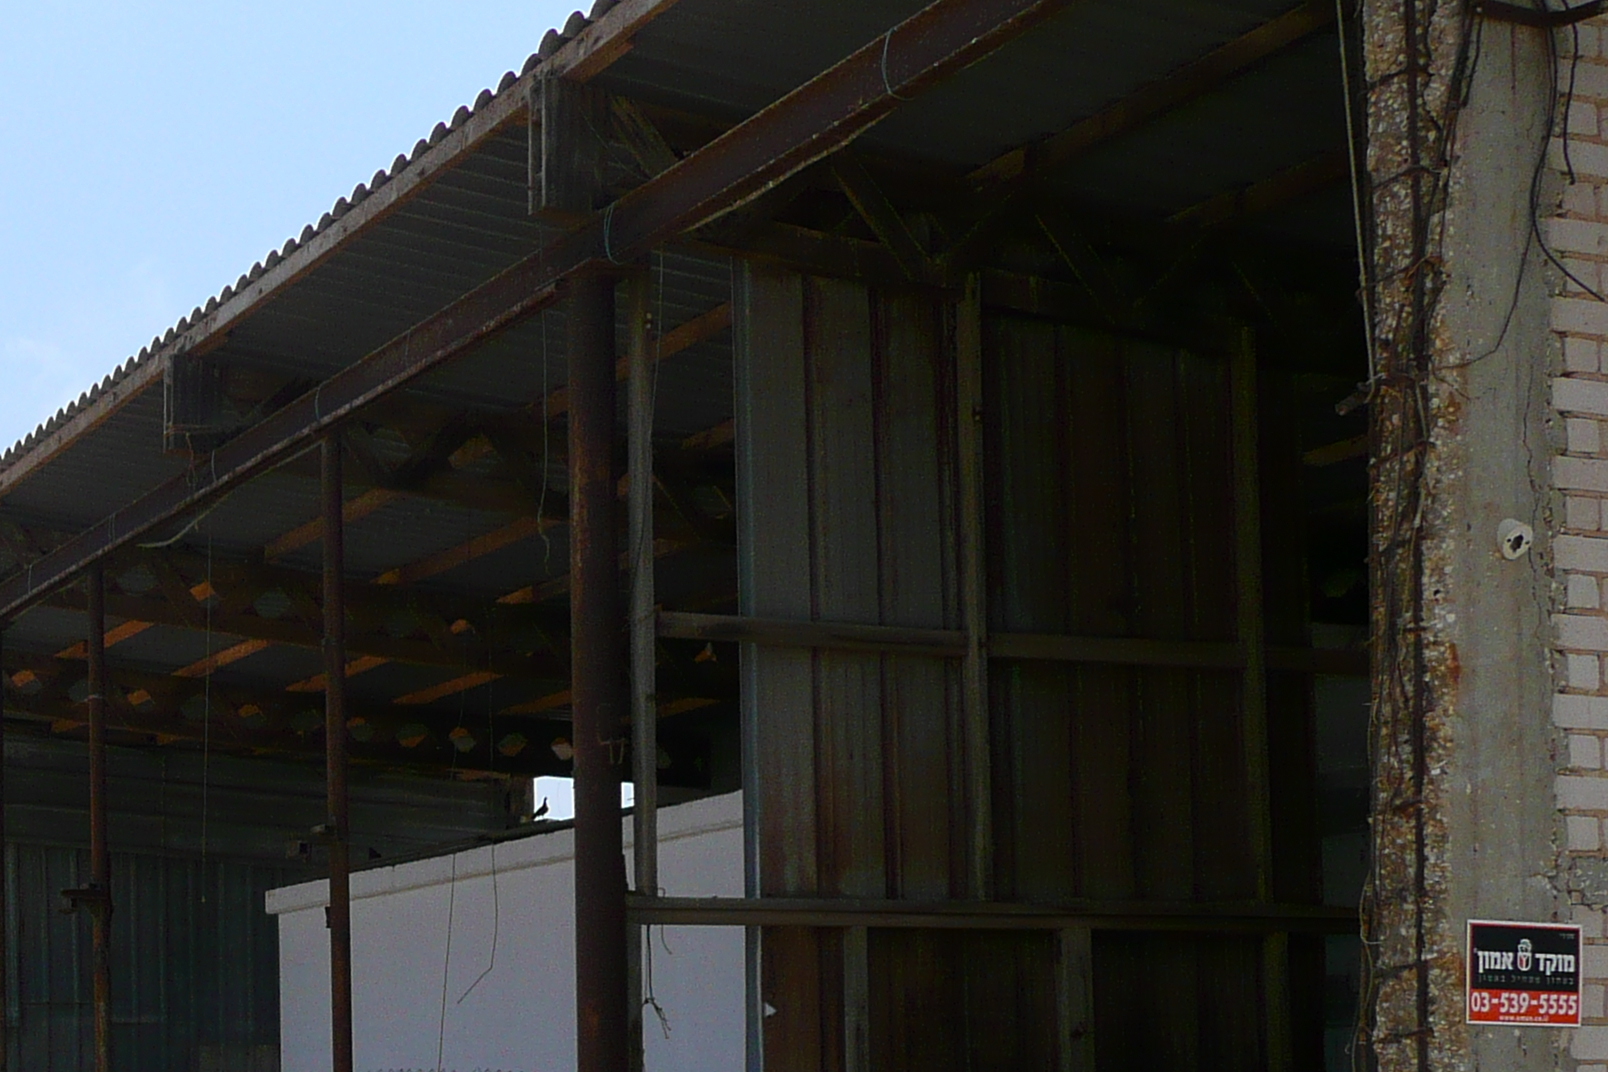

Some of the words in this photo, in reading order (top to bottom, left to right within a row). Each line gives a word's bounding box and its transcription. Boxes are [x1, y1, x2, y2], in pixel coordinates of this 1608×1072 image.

[1476, 951, 1513, 973] אמון
[1534, 953, 1575, 975] מוקד
[1471, 992, 1577, 1015] 03-539-5555
